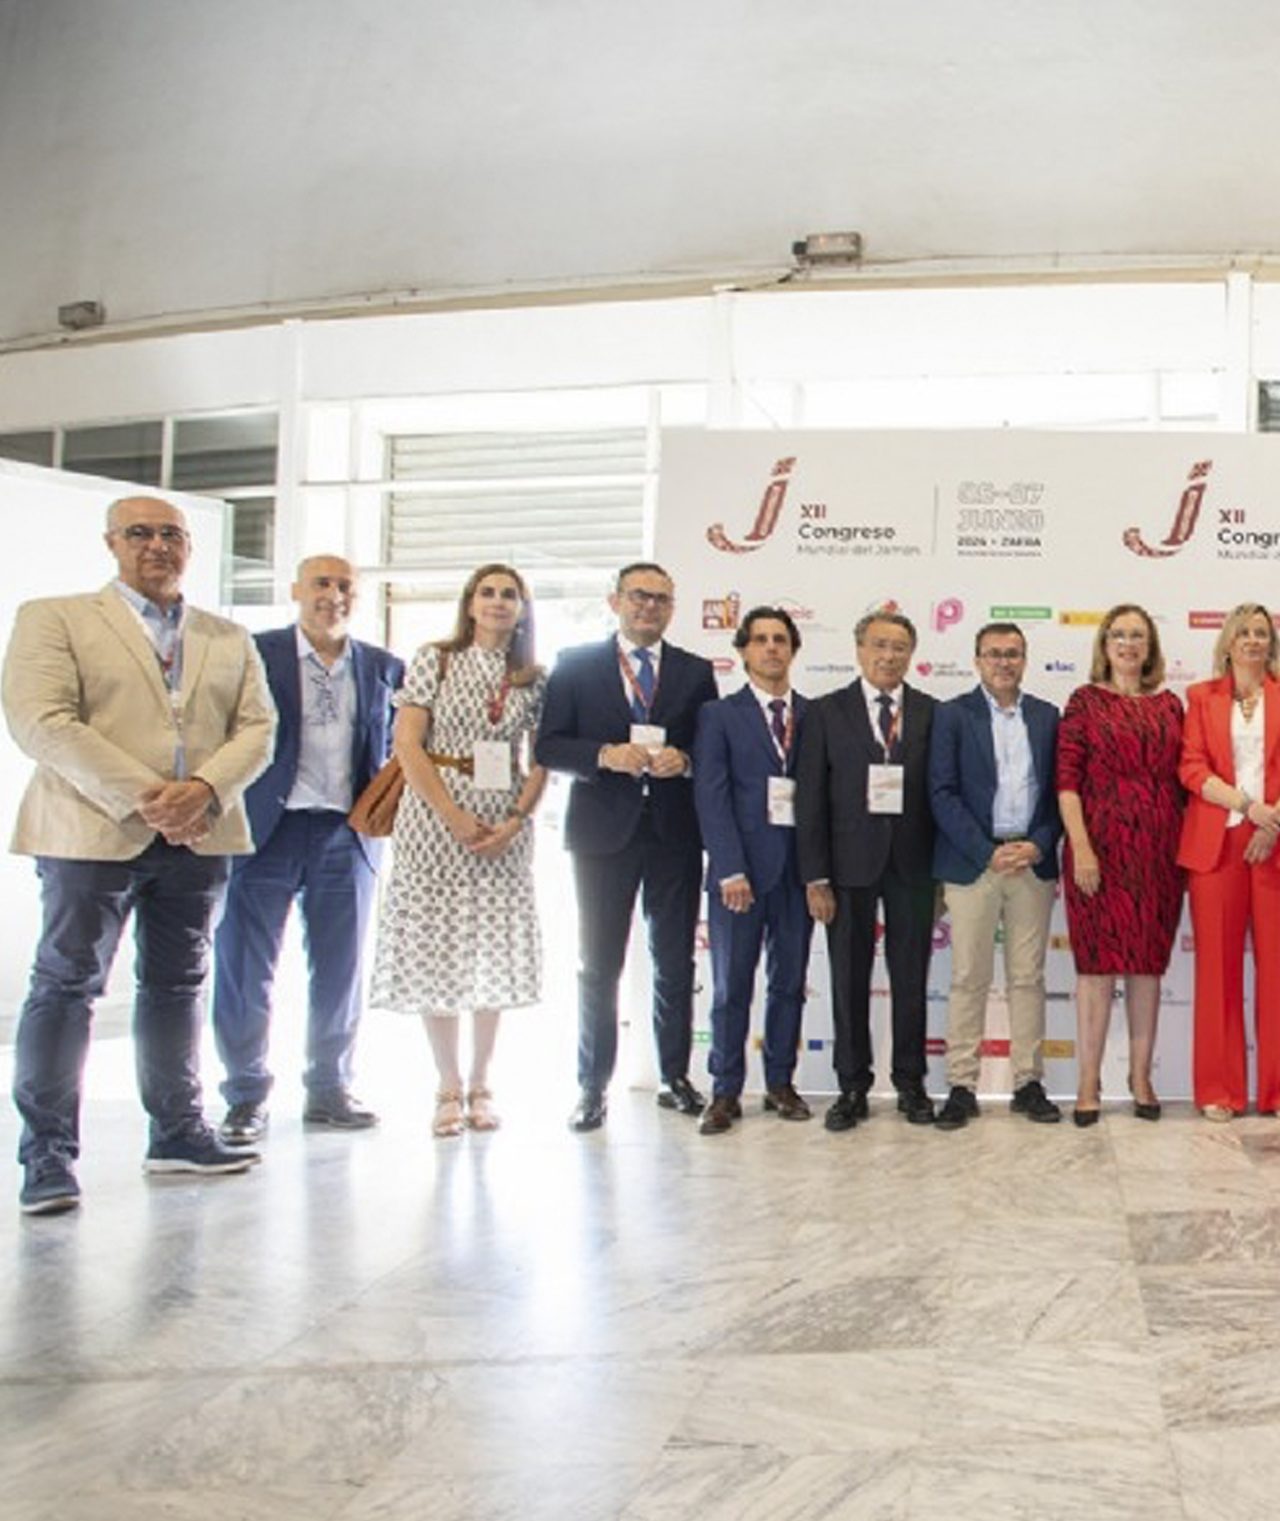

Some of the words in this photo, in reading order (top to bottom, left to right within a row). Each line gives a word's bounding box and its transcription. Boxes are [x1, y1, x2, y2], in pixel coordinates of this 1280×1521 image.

[800, 503, 827, 519] XII
[1218, 508, 1245, 524] XII
[798, 522, 896, 542] Congreso
